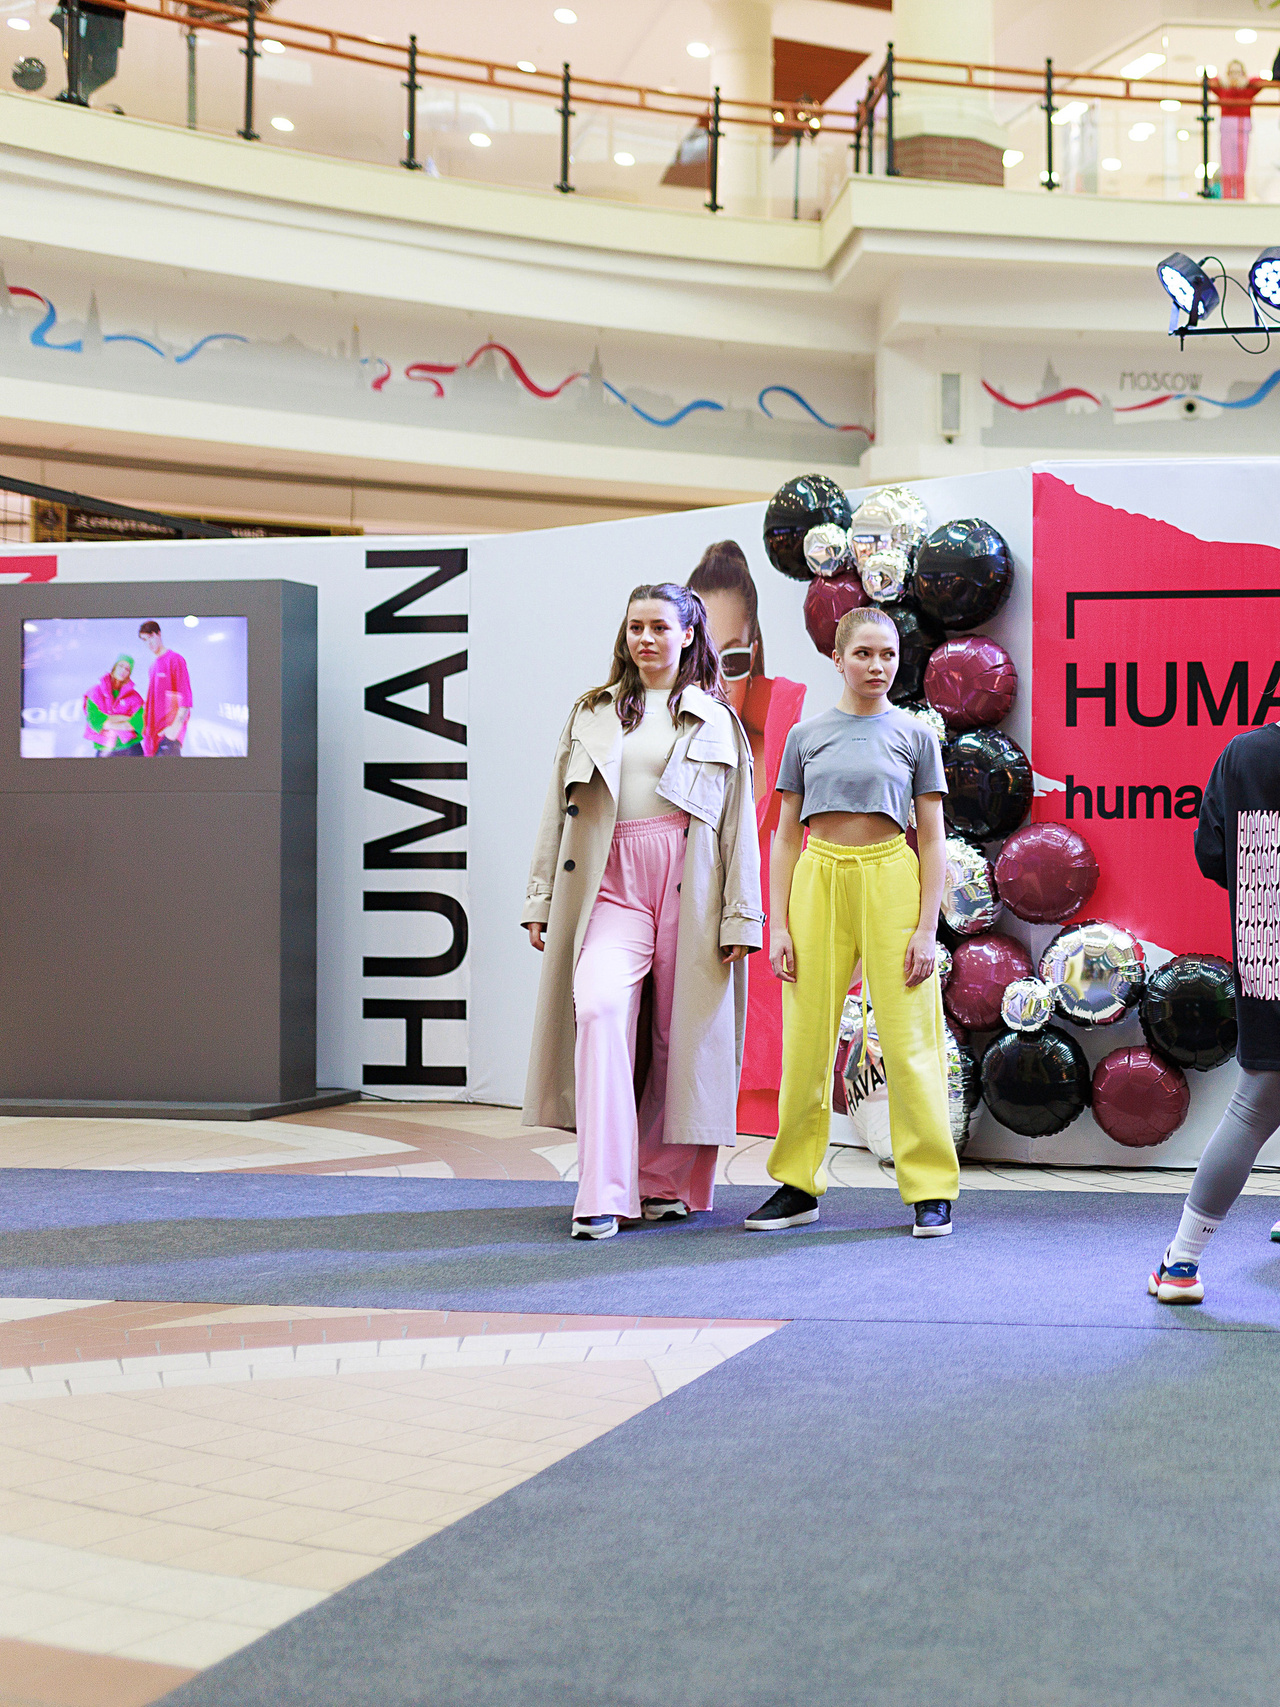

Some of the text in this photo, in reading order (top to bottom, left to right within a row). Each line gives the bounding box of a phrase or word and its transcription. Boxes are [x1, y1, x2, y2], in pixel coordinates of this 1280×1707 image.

[1119, 372, 1202, 392] MOSCOW
[362, 547, 469, 1086] HUMAN
[1065, 775, 1203, 820] huma
